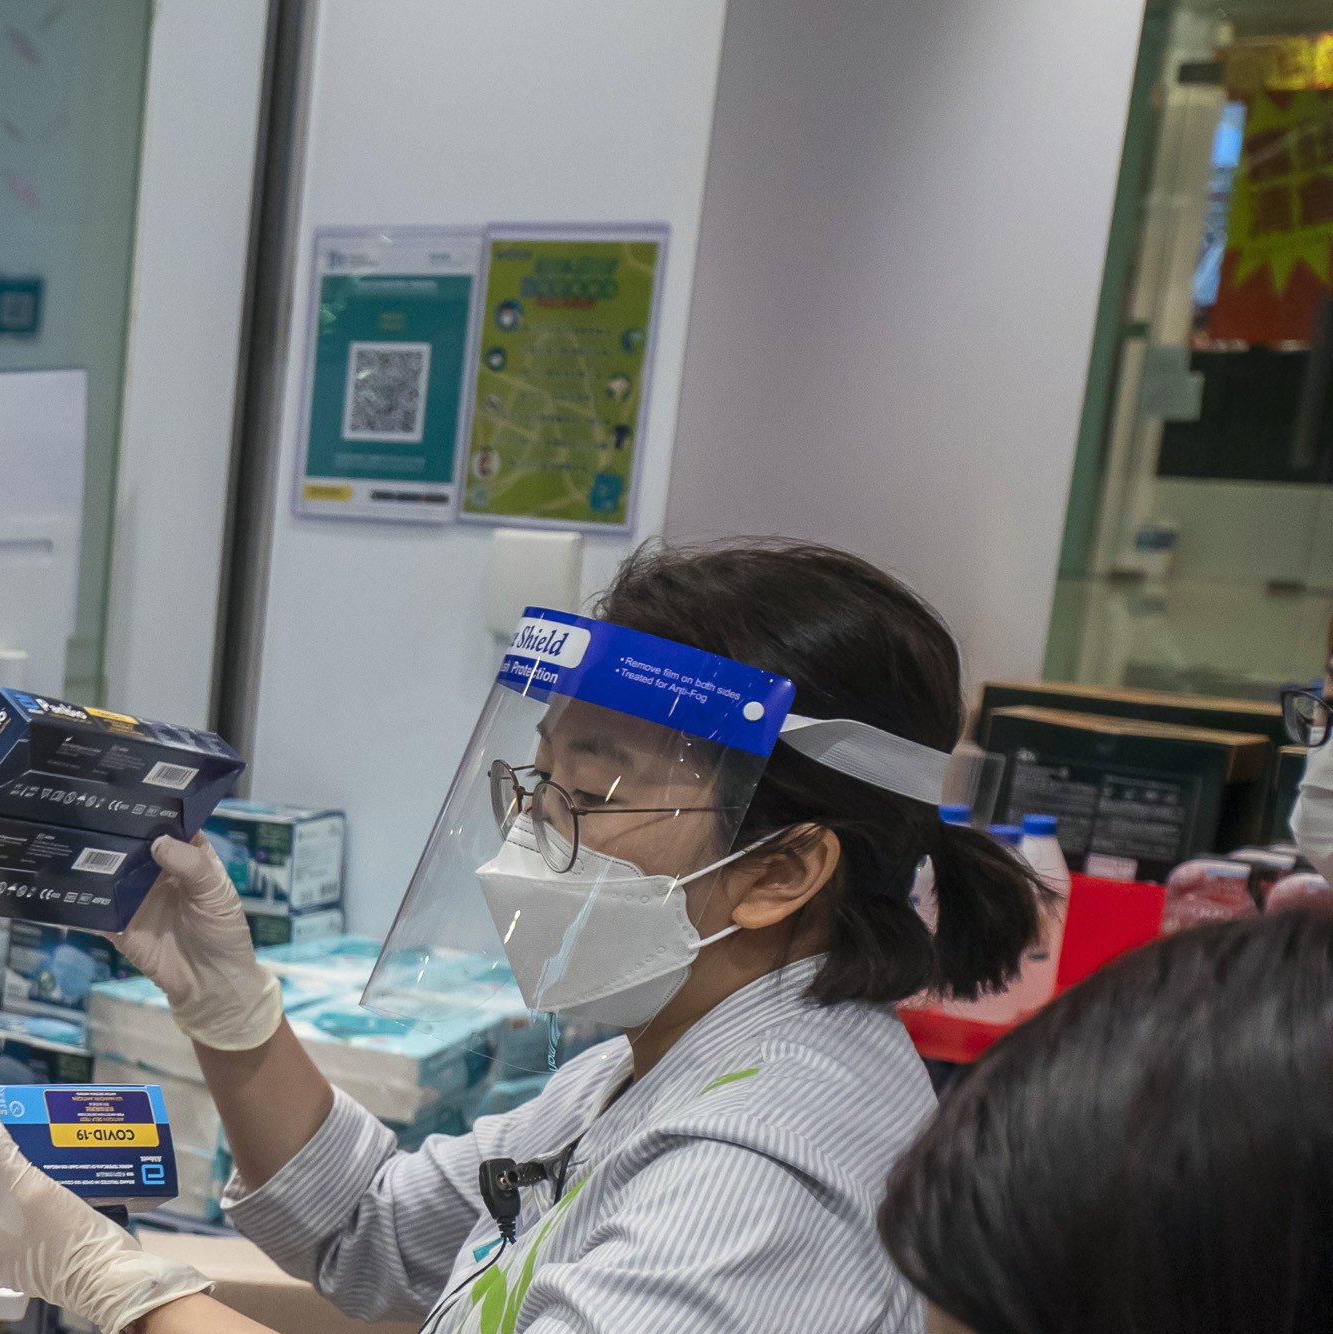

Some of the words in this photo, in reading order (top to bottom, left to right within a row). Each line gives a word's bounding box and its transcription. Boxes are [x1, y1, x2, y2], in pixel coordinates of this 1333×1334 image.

[517, 625, 569, 656] Shield
[511, 661, 559, 684] Protection
[621, 668, 653, 685] Treated
[655, 678, 667, 688] for
[668, 684, 707, 704] Anti-Fog
[625, 656, 661, 674] Remove
[663, 668, 679, 680] film
[681, 675, 693, 684] on
[695, 678, 715, 692] both
[717, 686, 741, 700] sides
[36, 698, 87, 720] Panbio
[77, 1129, 135, 1141] COVID-19
